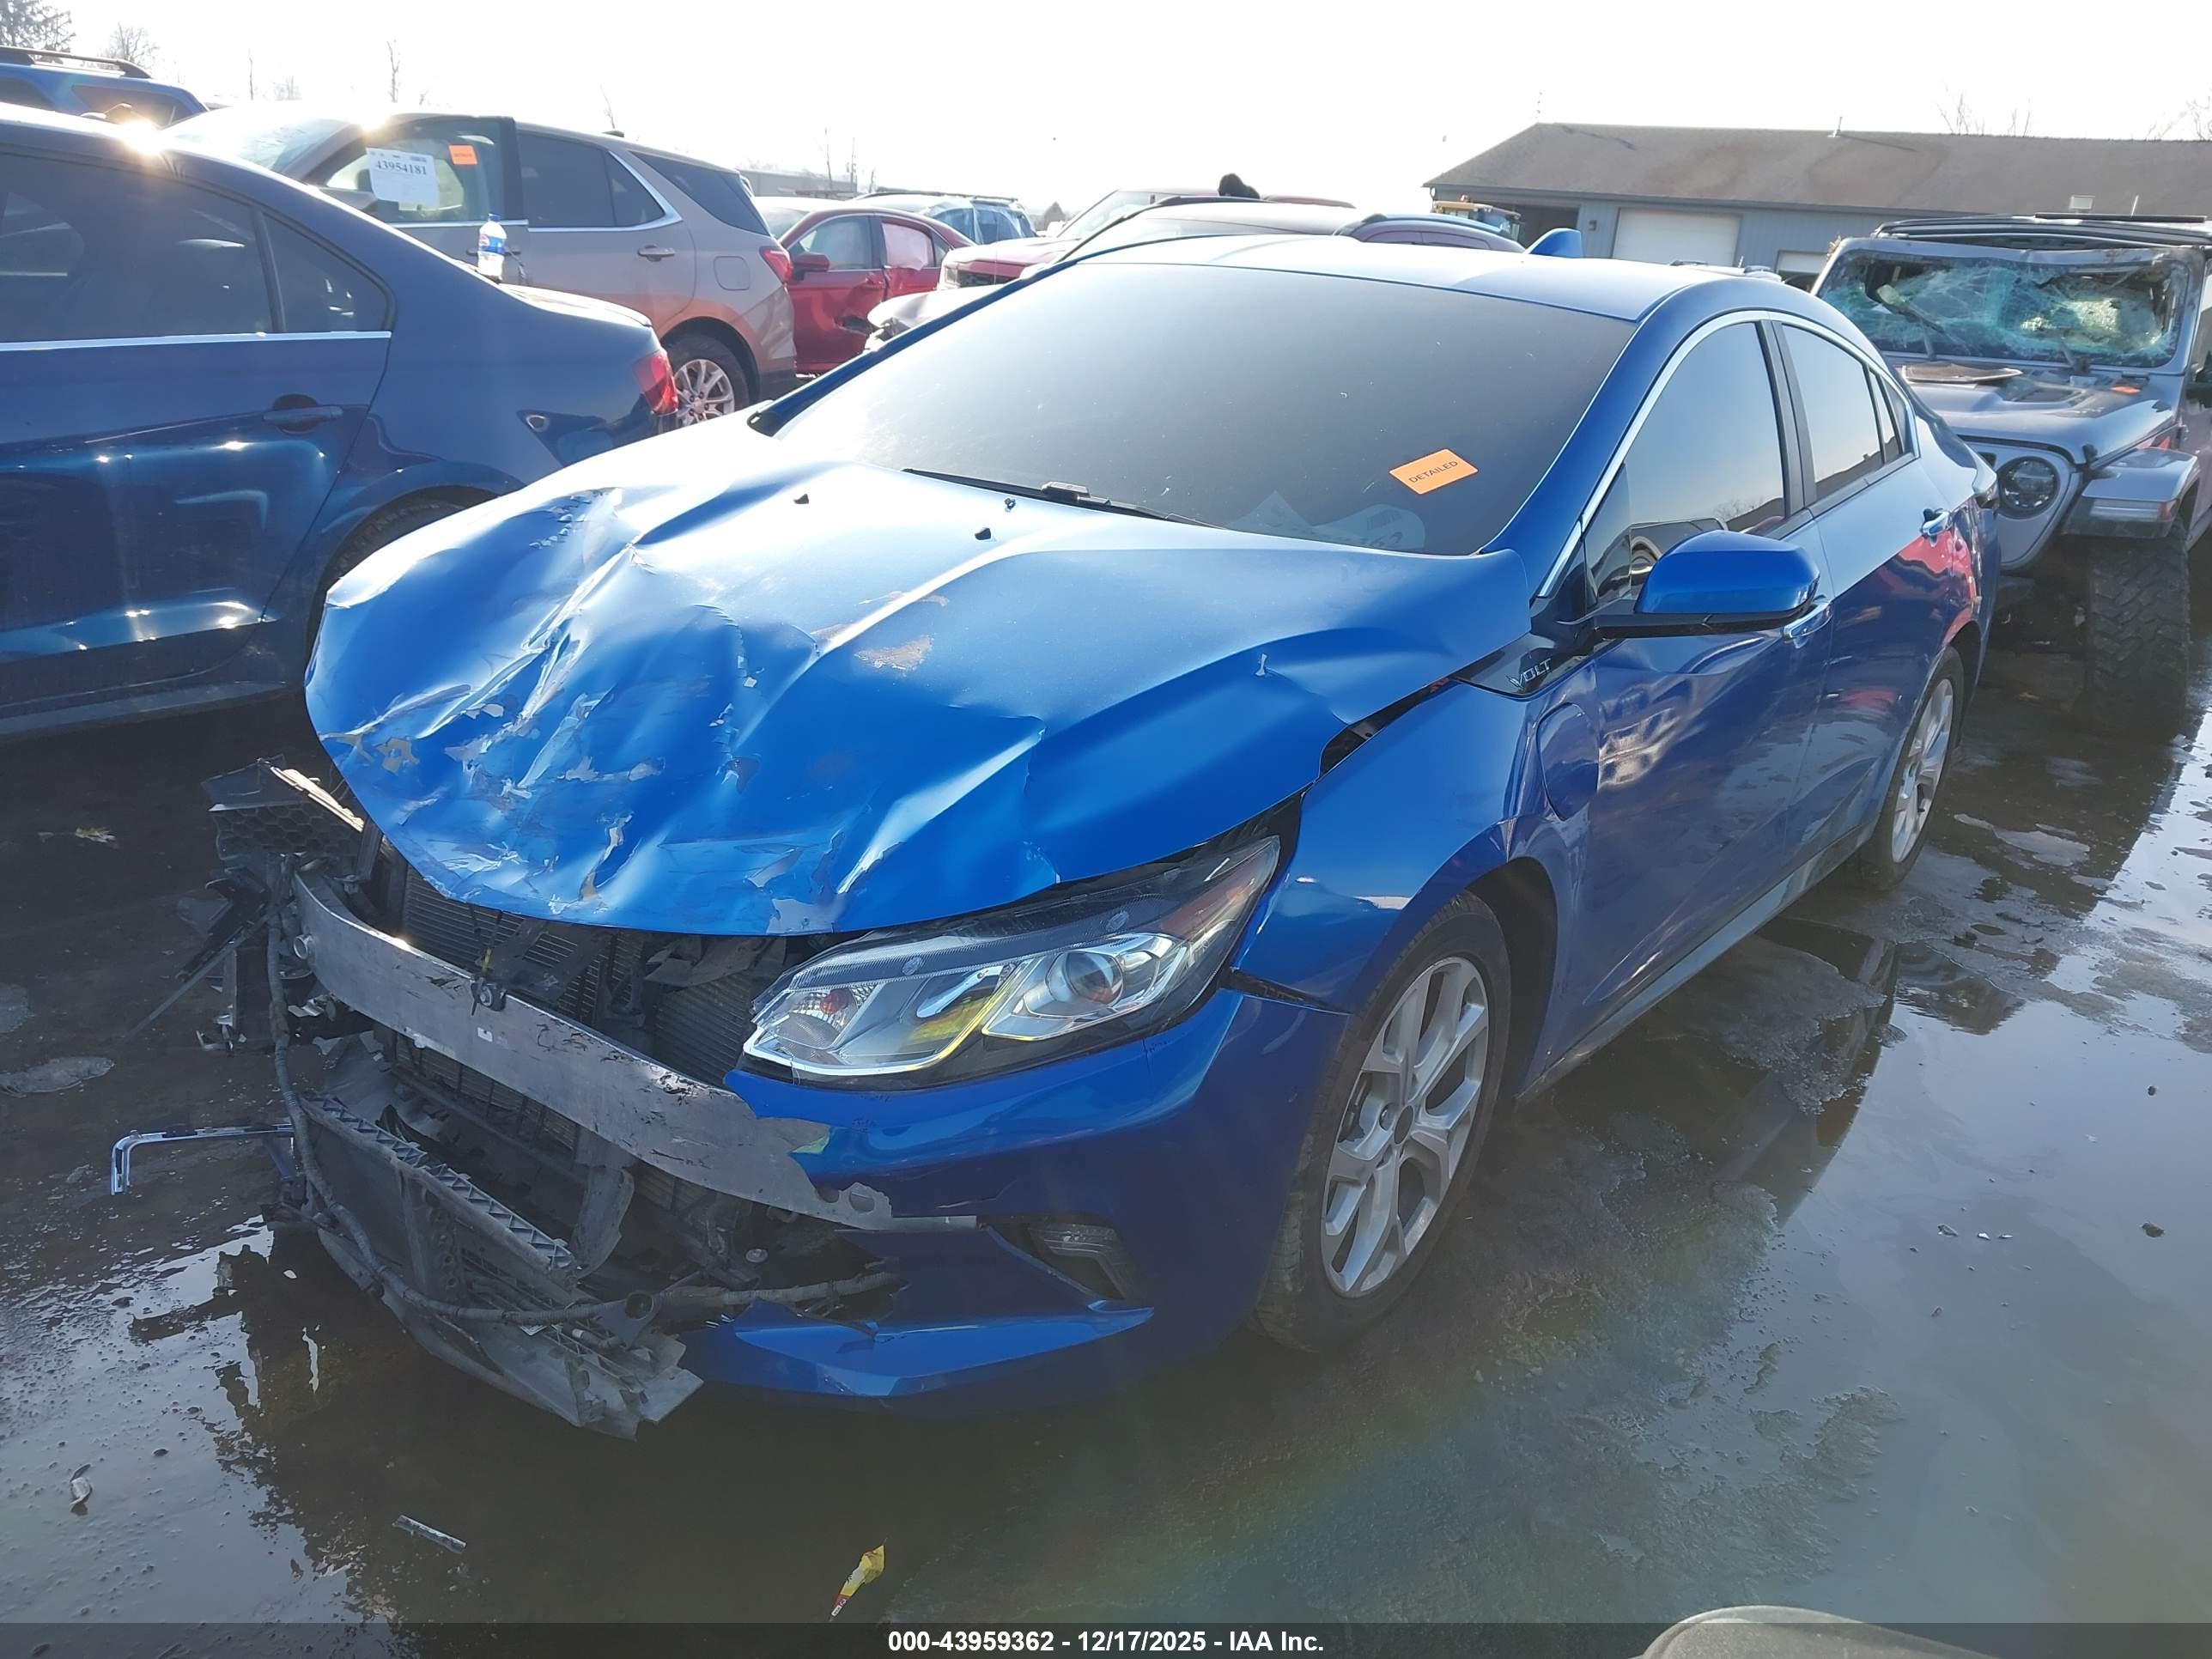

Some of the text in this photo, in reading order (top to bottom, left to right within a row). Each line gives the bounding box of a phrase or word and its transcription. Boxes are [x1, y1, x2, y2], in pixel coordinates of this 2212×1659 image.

[374, 160, 427, 175] 43954181
[1407, 460, 1459, 483] DETAILED
[1505, 658, 1552, 690] VOLT
